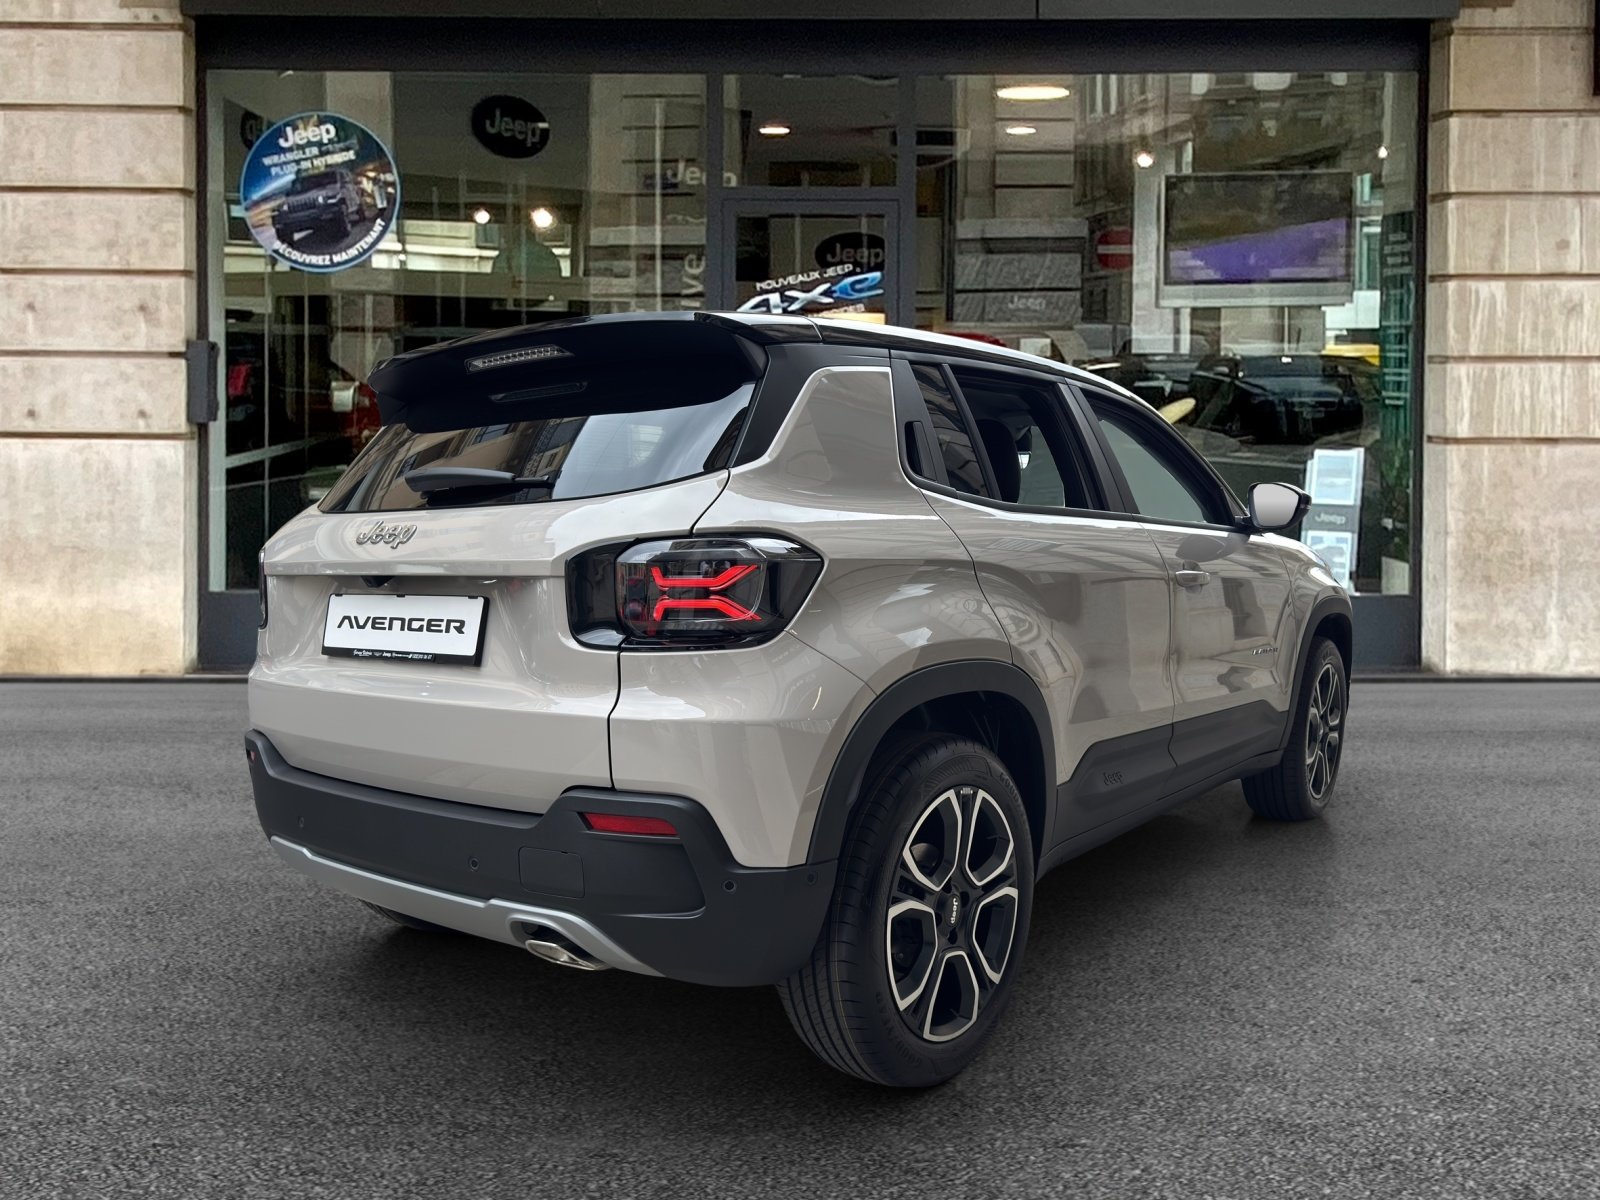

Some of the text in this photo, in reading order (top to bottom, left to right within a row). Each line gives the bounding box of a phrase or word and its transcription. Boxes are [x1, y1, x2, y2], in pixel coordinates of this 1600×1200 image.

[278, 123, 337, 148] Jeep
[485, 107, 542, 147] Jeep
[262, 146, 320, 167] WRANGLER
[270, 159, 312, 177] PLUG-IN
[667, 159, 738, 188] Jep
[332, 217, 386, 264] MAINTENANT
[826, 242, 884, 267] Jeep
[755, 263, 854, 292] NOUVEAUX JEEP
[1315, 512, 1347, 525] Jeep
[356, 520, 417, 549] Jeep
[337, 615, 466, 635] AVENGER
[950, 897, 959, 924] Jeep
